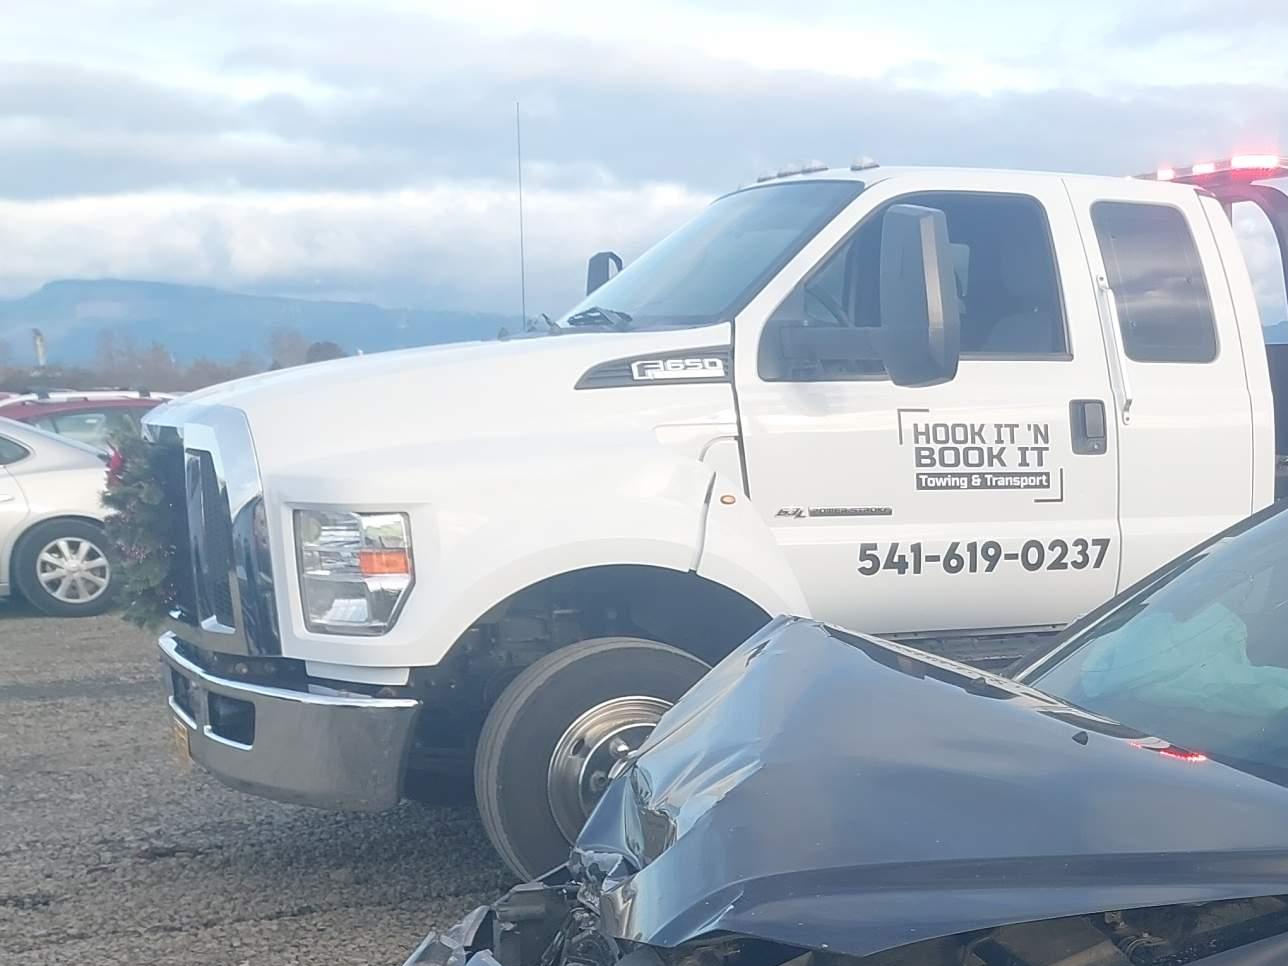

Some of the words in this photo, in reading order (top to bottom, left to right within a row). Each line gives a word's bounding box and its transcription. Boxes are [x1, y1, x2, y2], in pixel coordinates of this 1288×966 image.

[913, 423, 986, 445] HOOK
[993, 423, 1019, 444] IT
[1027, 423, 1050, 444] 'N
[914, 446, 1007, 468] BOOK
[1017, 446, 1049, 467] IT
[919, 475, 968, 489] Towing
[971, 475, 981, 487] &
[985, 474, 1048, 488] Transport
[857, 538, 1110, 576] 541-619-0237
